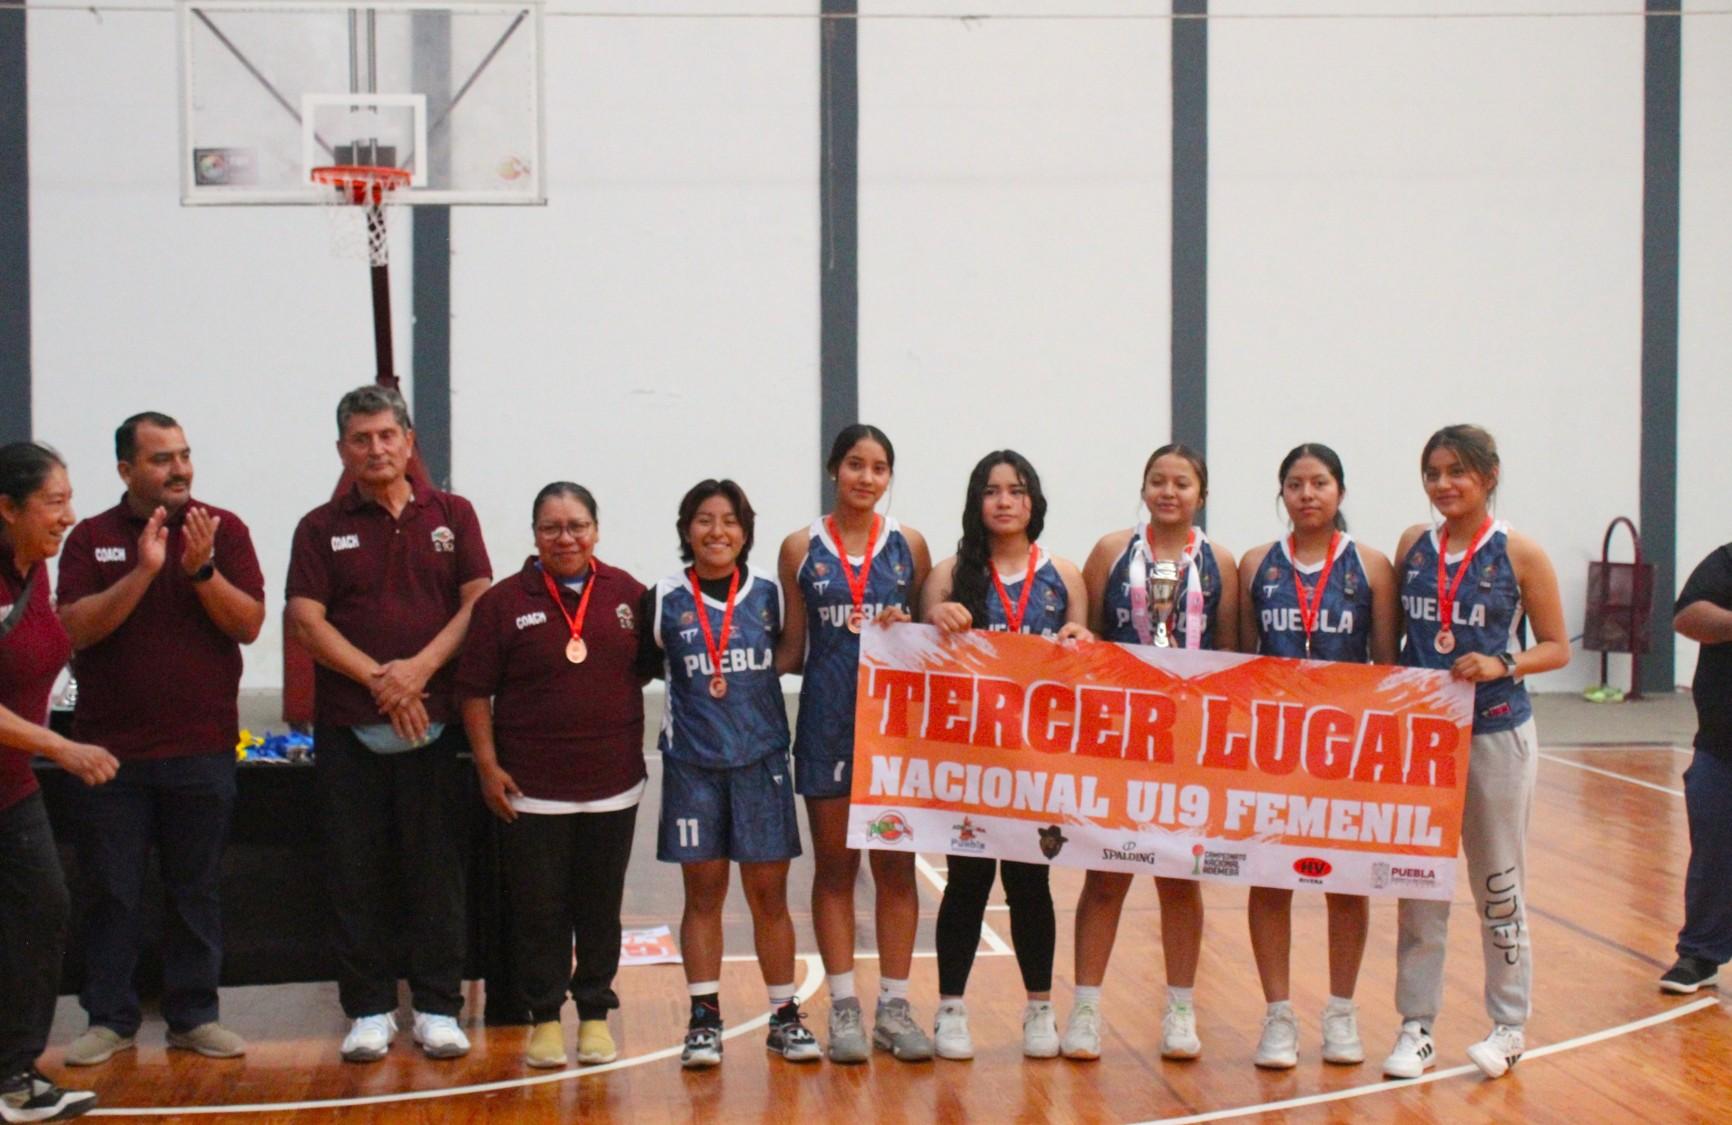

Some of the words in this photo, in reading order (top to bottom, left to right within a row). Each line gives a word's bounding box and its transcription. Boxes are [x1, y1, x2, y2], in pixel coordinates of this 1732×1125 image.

[95, 547, 127, 562] COACH
[331, 534, 360, 552] COACH
[516, 611, 547, 630] COACH
[1401, 595, 1486, 627] PUELA
[683, 648, 773, 678] PUEBLA
[867, 666, 1177, 764] TERCER
[1197, 695, 1460, 788] LUGAR
[869, 755, 1110, 818] NACIONAL
[1126, 779, 1210, 827] U19
[1223, 789, 1443, 847] FEMENIL
[676, 818, 699, 848] 11
[1102, 848, 1156, 865] SPALDING
[1391, 867, 1436, 880] PUEBLA
